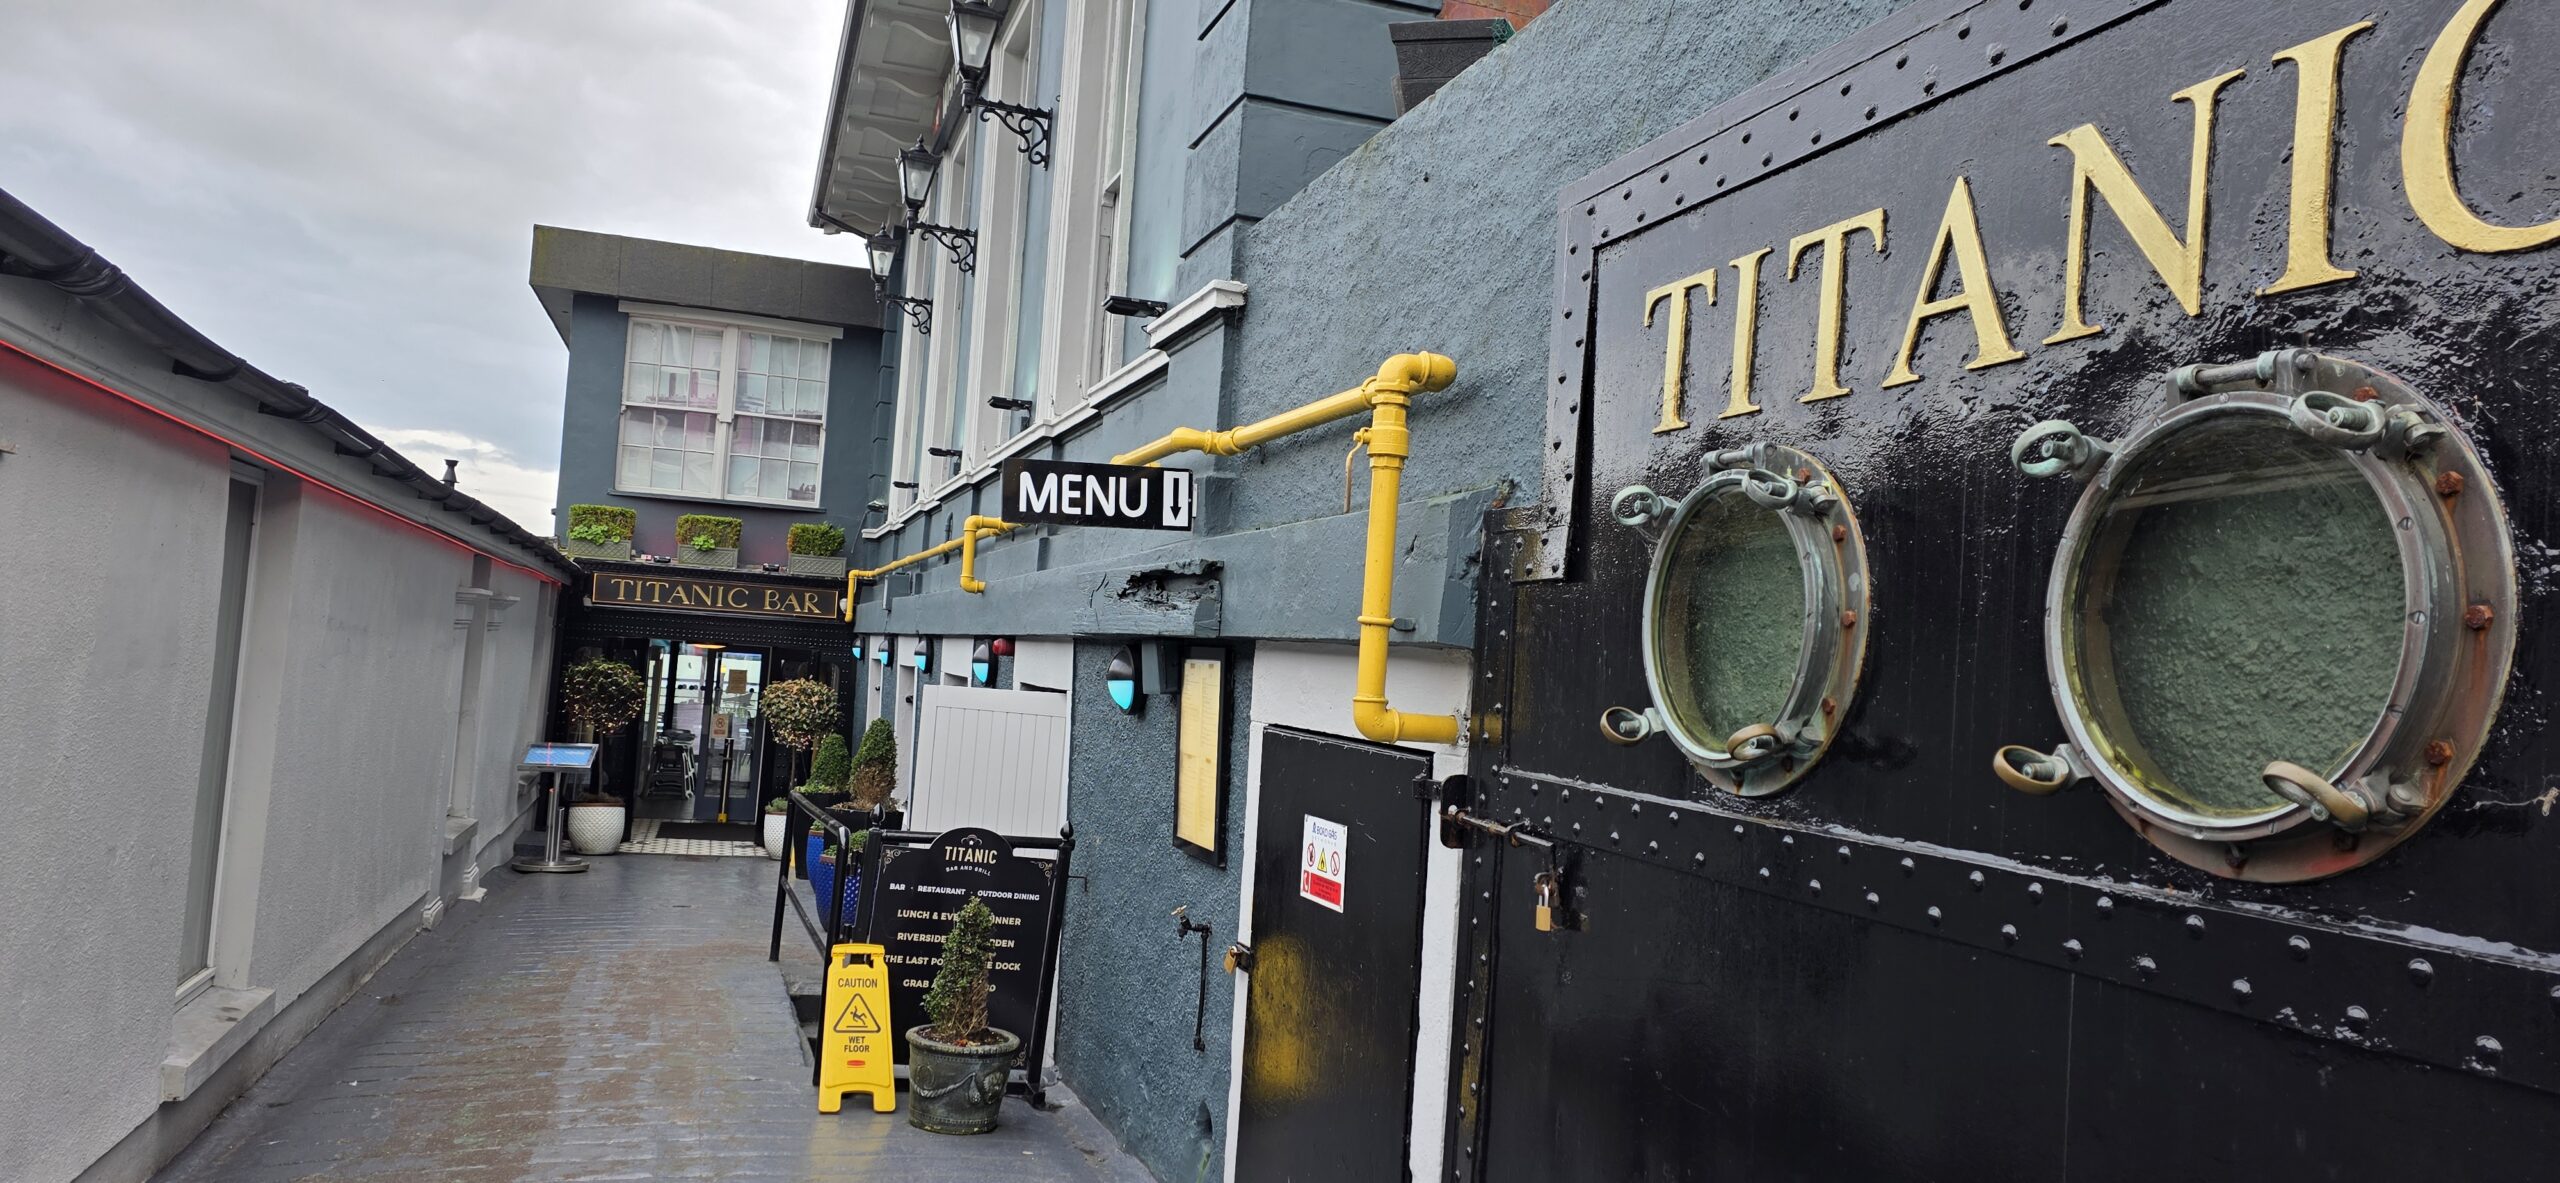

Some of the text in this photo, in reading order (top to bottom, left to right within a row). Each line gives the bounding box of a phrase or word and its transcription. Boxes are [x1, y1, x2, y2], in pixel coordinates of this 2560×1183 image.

[1019, 471, 1148, 518] MENU
[611, 578, 822, 614] TITANIC BAR
[944, 846, 998, 865] TITANIC
[945, 865, 958, 873] BAR
[974, 866, 991, 877] GRILL
[889, 882, 1040, 901] BAR RESTAURANT OUTDOOR DINING
[897, 909, 930, 920] LUNCH
[932, 911, 939, 920] &
[990, 914, 1021, 926] INNER
[897, 932, 947, 944] RIVERSIDE
[885, 955, 903, 964] THE
[906, 956, 929, 966] LAST
[995, 961, 1021, 971] DOCK
[838, 978, 878, 988] CAUTION
[903, 978, 929, 988] GRAB
[848, 1036, 866, 1044] WET
[844, 1045, 870, 1053] FLOOR
